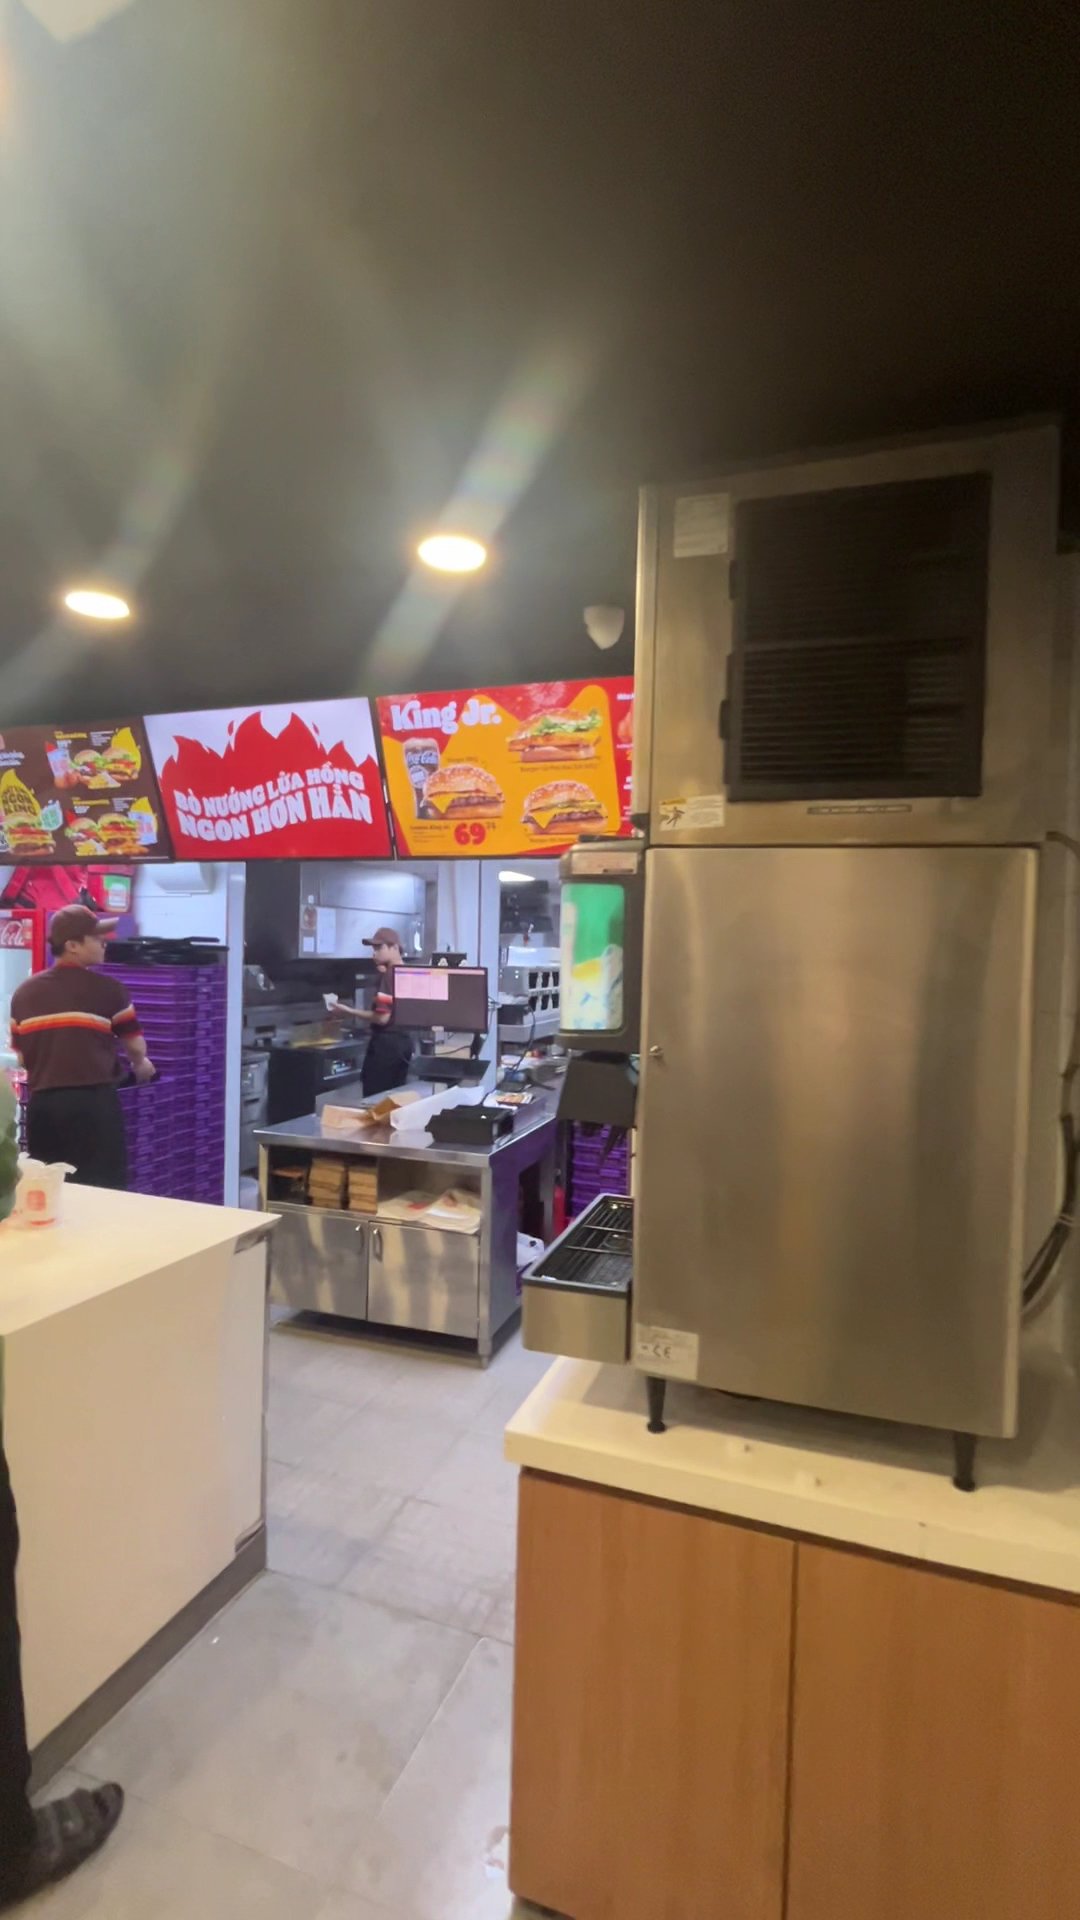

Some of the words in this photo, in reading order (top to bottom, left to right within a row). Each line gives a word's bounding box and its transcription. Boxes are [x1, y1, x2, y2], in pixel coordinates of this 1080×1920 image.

[390, 700, 458, 735] King
[461, 698, 502, 727] Jr.
[173, 788, 202, 817] BÒ
[266, 771, 305, 800] LỬA
[306, 761, 366, 791] HỒNG
[176, 810, 251, 842] NGON
[251, 791, 307, 836] HƠN
[454, 822, 487, 846] 69
